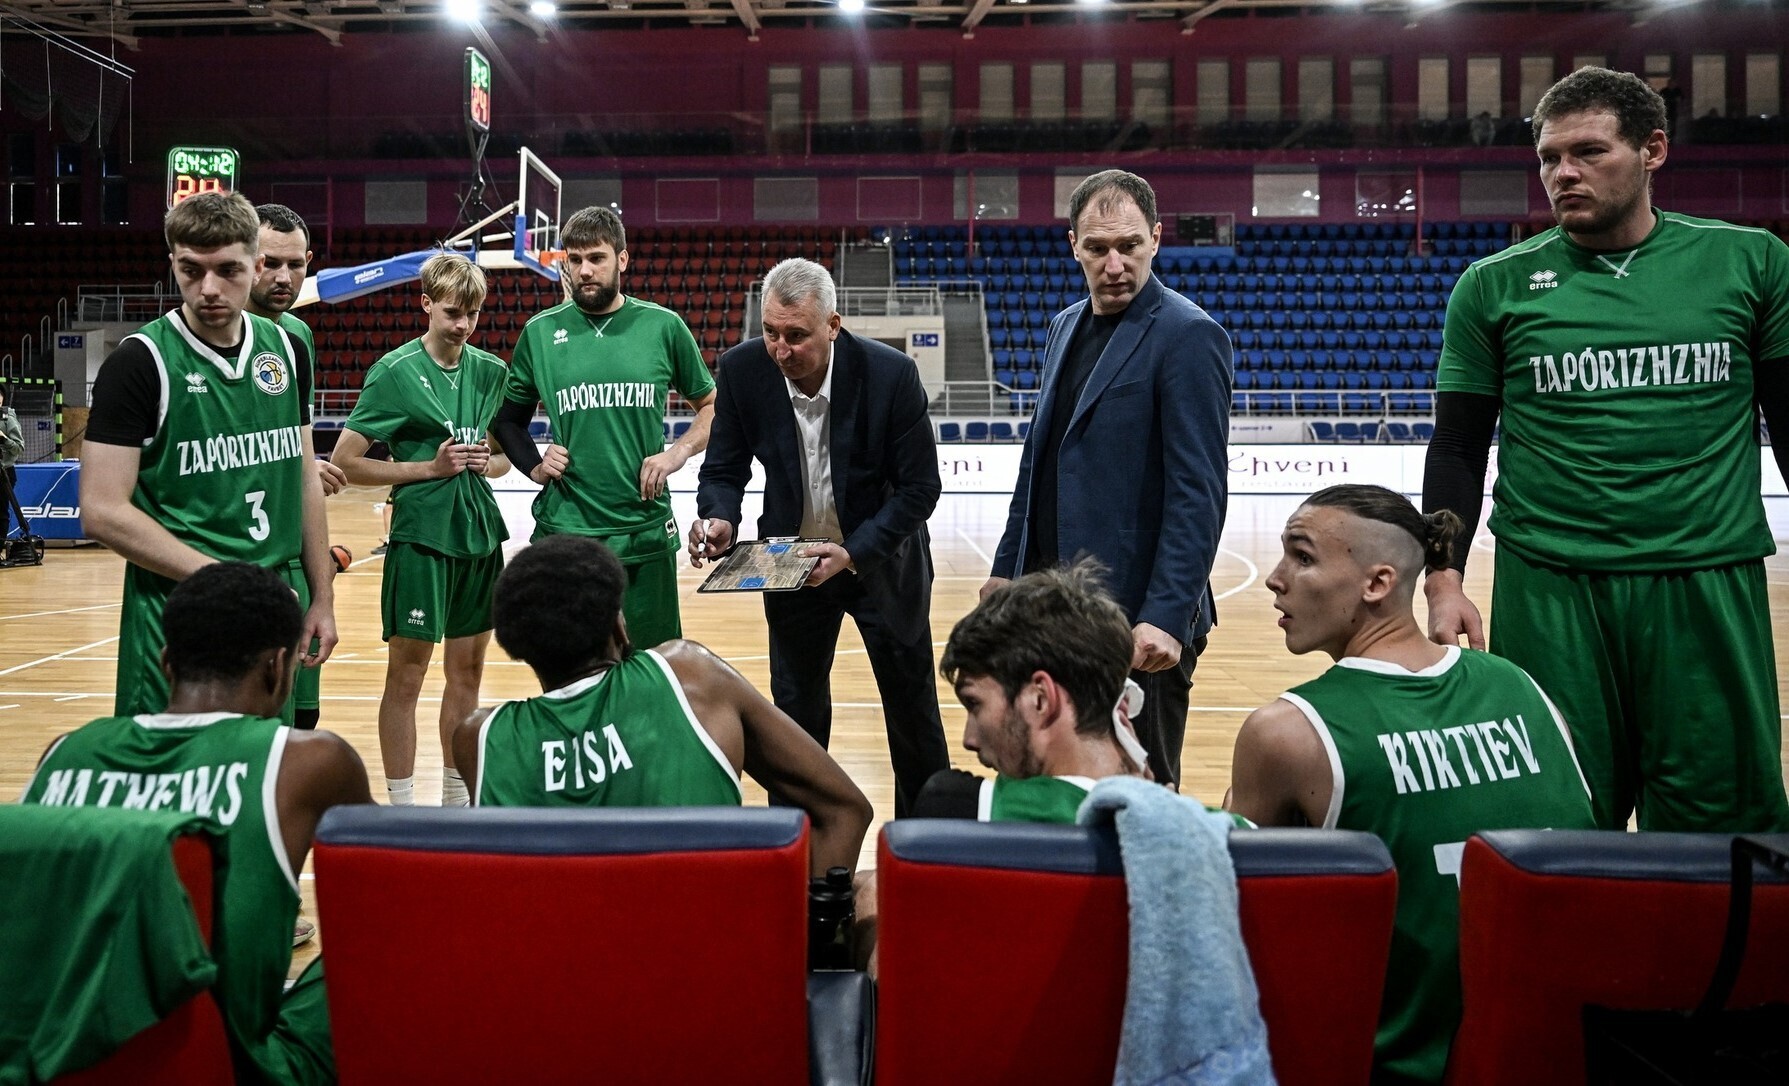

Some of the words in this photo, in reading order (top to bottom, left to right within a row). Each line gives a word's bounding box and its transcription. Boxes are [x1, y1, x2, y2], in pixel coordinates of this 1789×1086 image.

[245, 490, 270, 541] 3
[541, 723, 633, 792] EISA
[40, 762, 248, 826] MATHEWS
